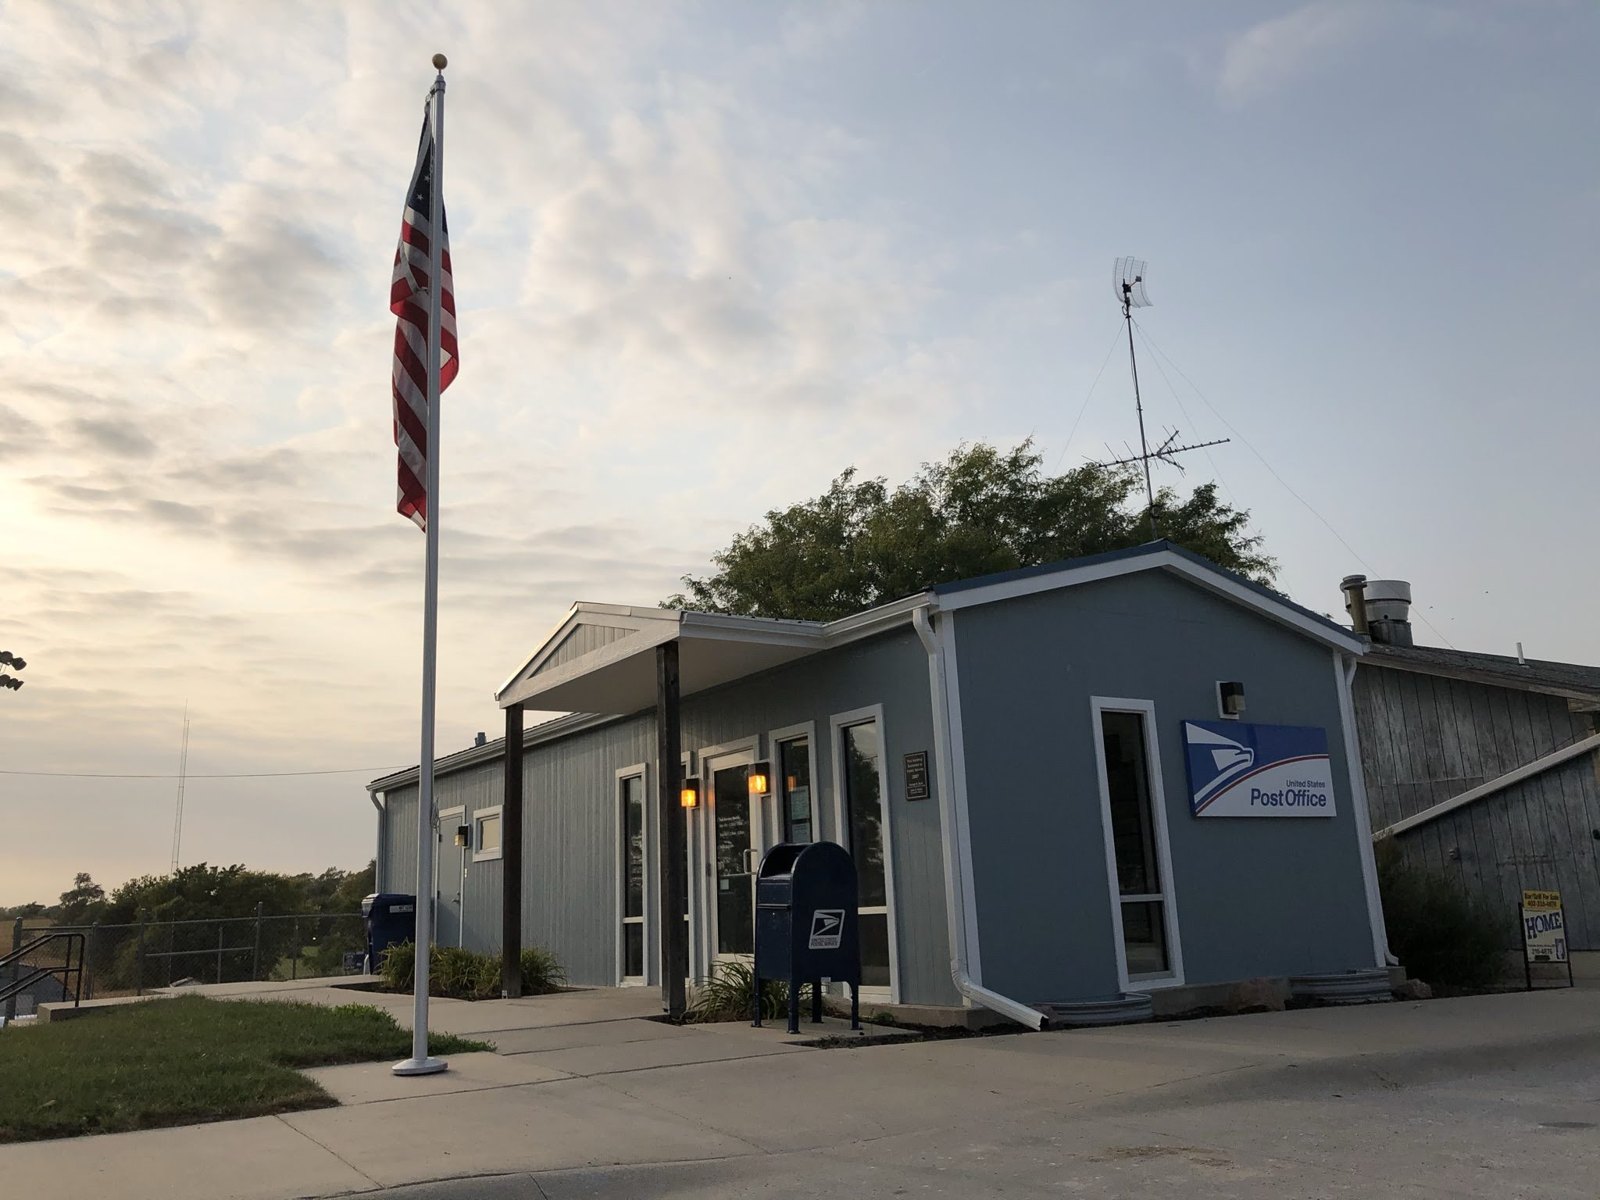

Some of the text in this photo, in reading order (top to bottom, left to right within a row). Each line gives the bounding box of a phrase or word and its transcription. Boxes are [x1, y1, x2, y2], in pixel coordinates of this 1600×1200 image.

[1286, 779, 1326, 788] United States
[1251, 788, 1327, 807] Post Office
[1525, 912, 1562, 939] HOME
